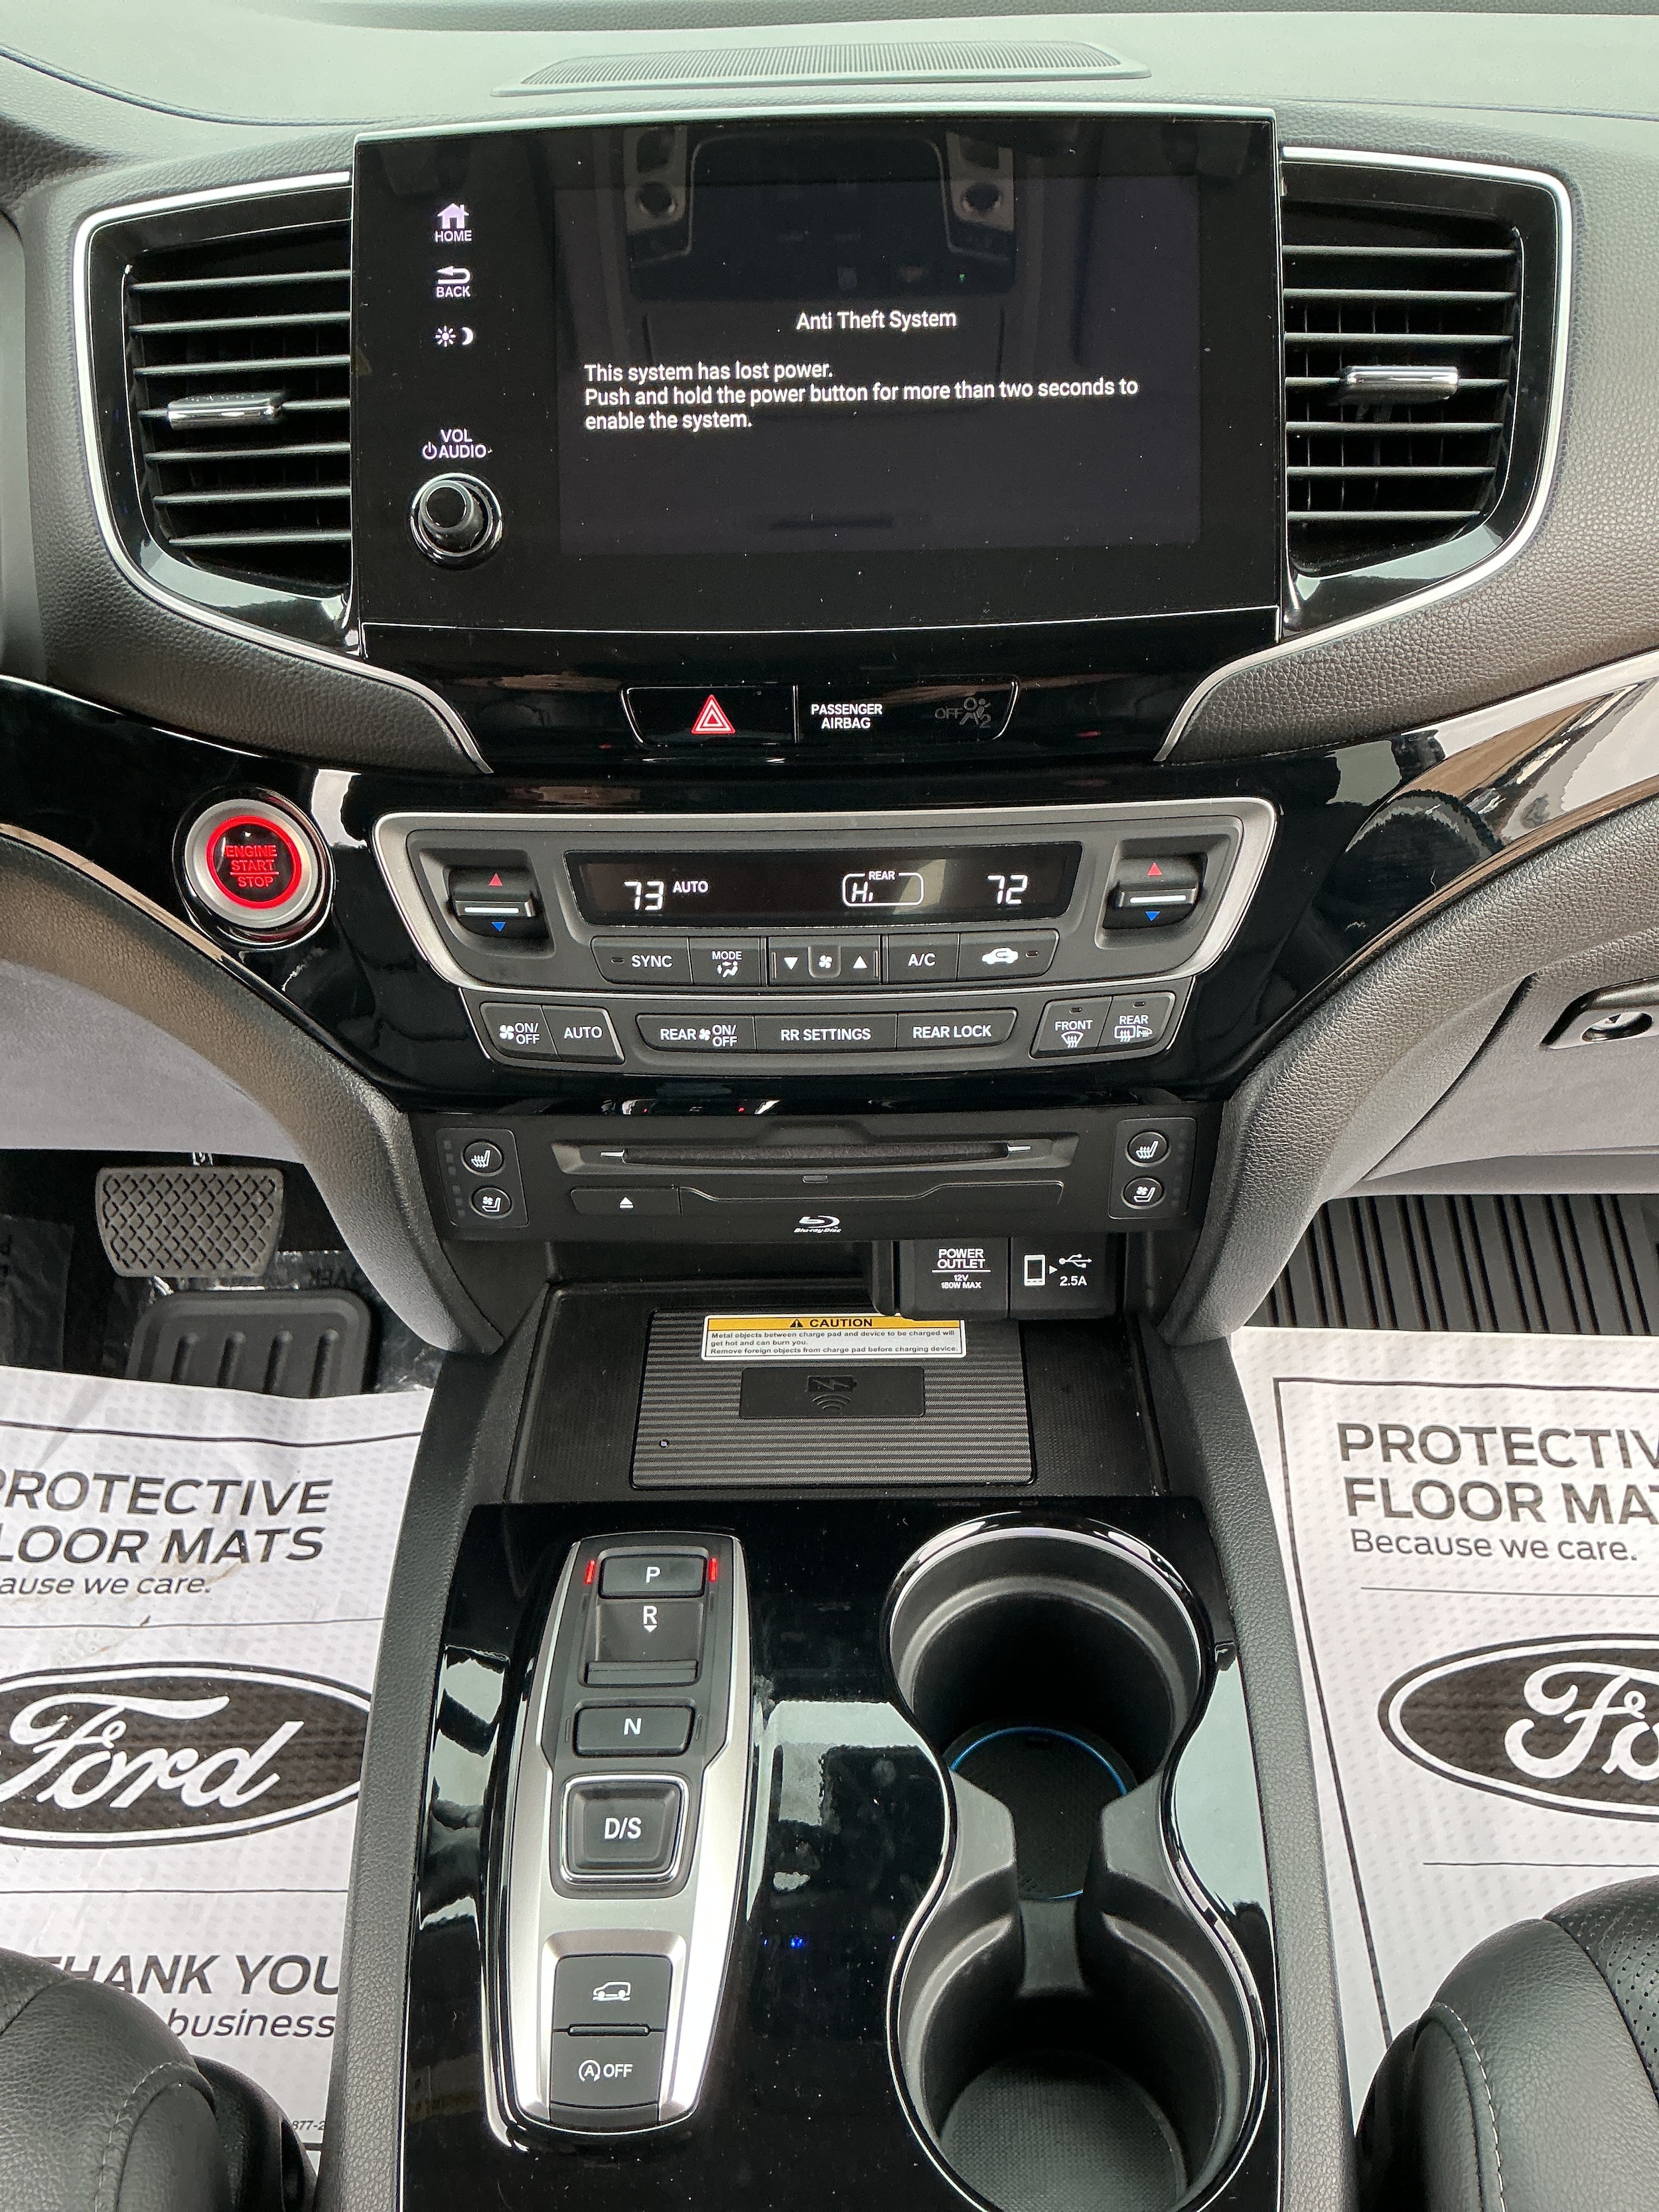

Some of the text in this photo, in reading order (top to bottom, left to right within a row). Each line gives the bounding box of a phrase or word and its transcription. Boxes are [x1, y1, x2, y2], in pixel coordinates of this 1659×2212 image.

[435, 230, 472, 242] HOME
[436, 286, 470, 298] BACK
[796, 310, 957, 332] Anti Theft System
[585, 360, 834, 384] This system has lost power.
[585, 378, 1139, 406] Push and hold the power button for more than two seconds to
[585, 411, 753, 431] enable the system.
[441, 429, 472, 443] VOL
[439, 445, 486, 459] AUDIO
[811, 703, 883, 717] PASSENGER
[934, 707, 963, 719] OFF
[822, 717, 871, 730] AIRBAG
[226, 845, 277, 858] ENGINE
[231, 859, 275, 871] START
[238, 876, 273, 887] STOP
[868, 871, 895, 881] REAR
[624, 881, 709, 911] 73 AUTO
[987, 874, 1028, 905] 72
[631, 954, 673, 968] SYNC
[712, 950, 743, 961] MODE
[908, 953, 936, 967] A/C
[1055, 1019, 1093, 1032] FRONT
[1119, 1014, 1149, 1025] REAR
[514, 1021, 539, 1034] ON/
[563, 1026, 603, 1039] AUTO
[660, 1028, 697, 1041] REAR
[712, 1024, 737, 1037] ON/
[780, 1027, 871, 1041] RR SETTINGS
[912, 1025, 992, 1039] REAR LOCK
[516, 1032, 540, 1045] OFF
[713, 1035, 737, 1047] OFF
[938, 1248, 984, 1259] POWER
[938, 1258, 986, 1270] OUTLET
[963, 1281, 982, 1290] MAX
[1059, 1276, 1087, 1287] 2.5A
[810, 1318, 873, 1327] CAUTION
[1337, 1422, 1659, 1469] PROTECTIV
[0, 1467, 333, 1516] ROTECTIVE
[1344, 1477, 1659, 1525] FLOOR MA
[161, 1526, 325, 1565] MATS
[1351, 1529, 1638, 1560] Because we care.
[646, 1566, 661, 1583] P
[0, 1576, 212, 1595] ause we care.
[643, 1606, 658, 1625] R
[623, 1718, 642, 1735] N
[1504, 1661, 1659, 1781] Fo
[0, 1692, 305, 1810] Ford
[604, 1817, 642, 1840] D/S
[236, 1955, 339, 1995] YOU
[603, 2064, 633, 2077] OFF
